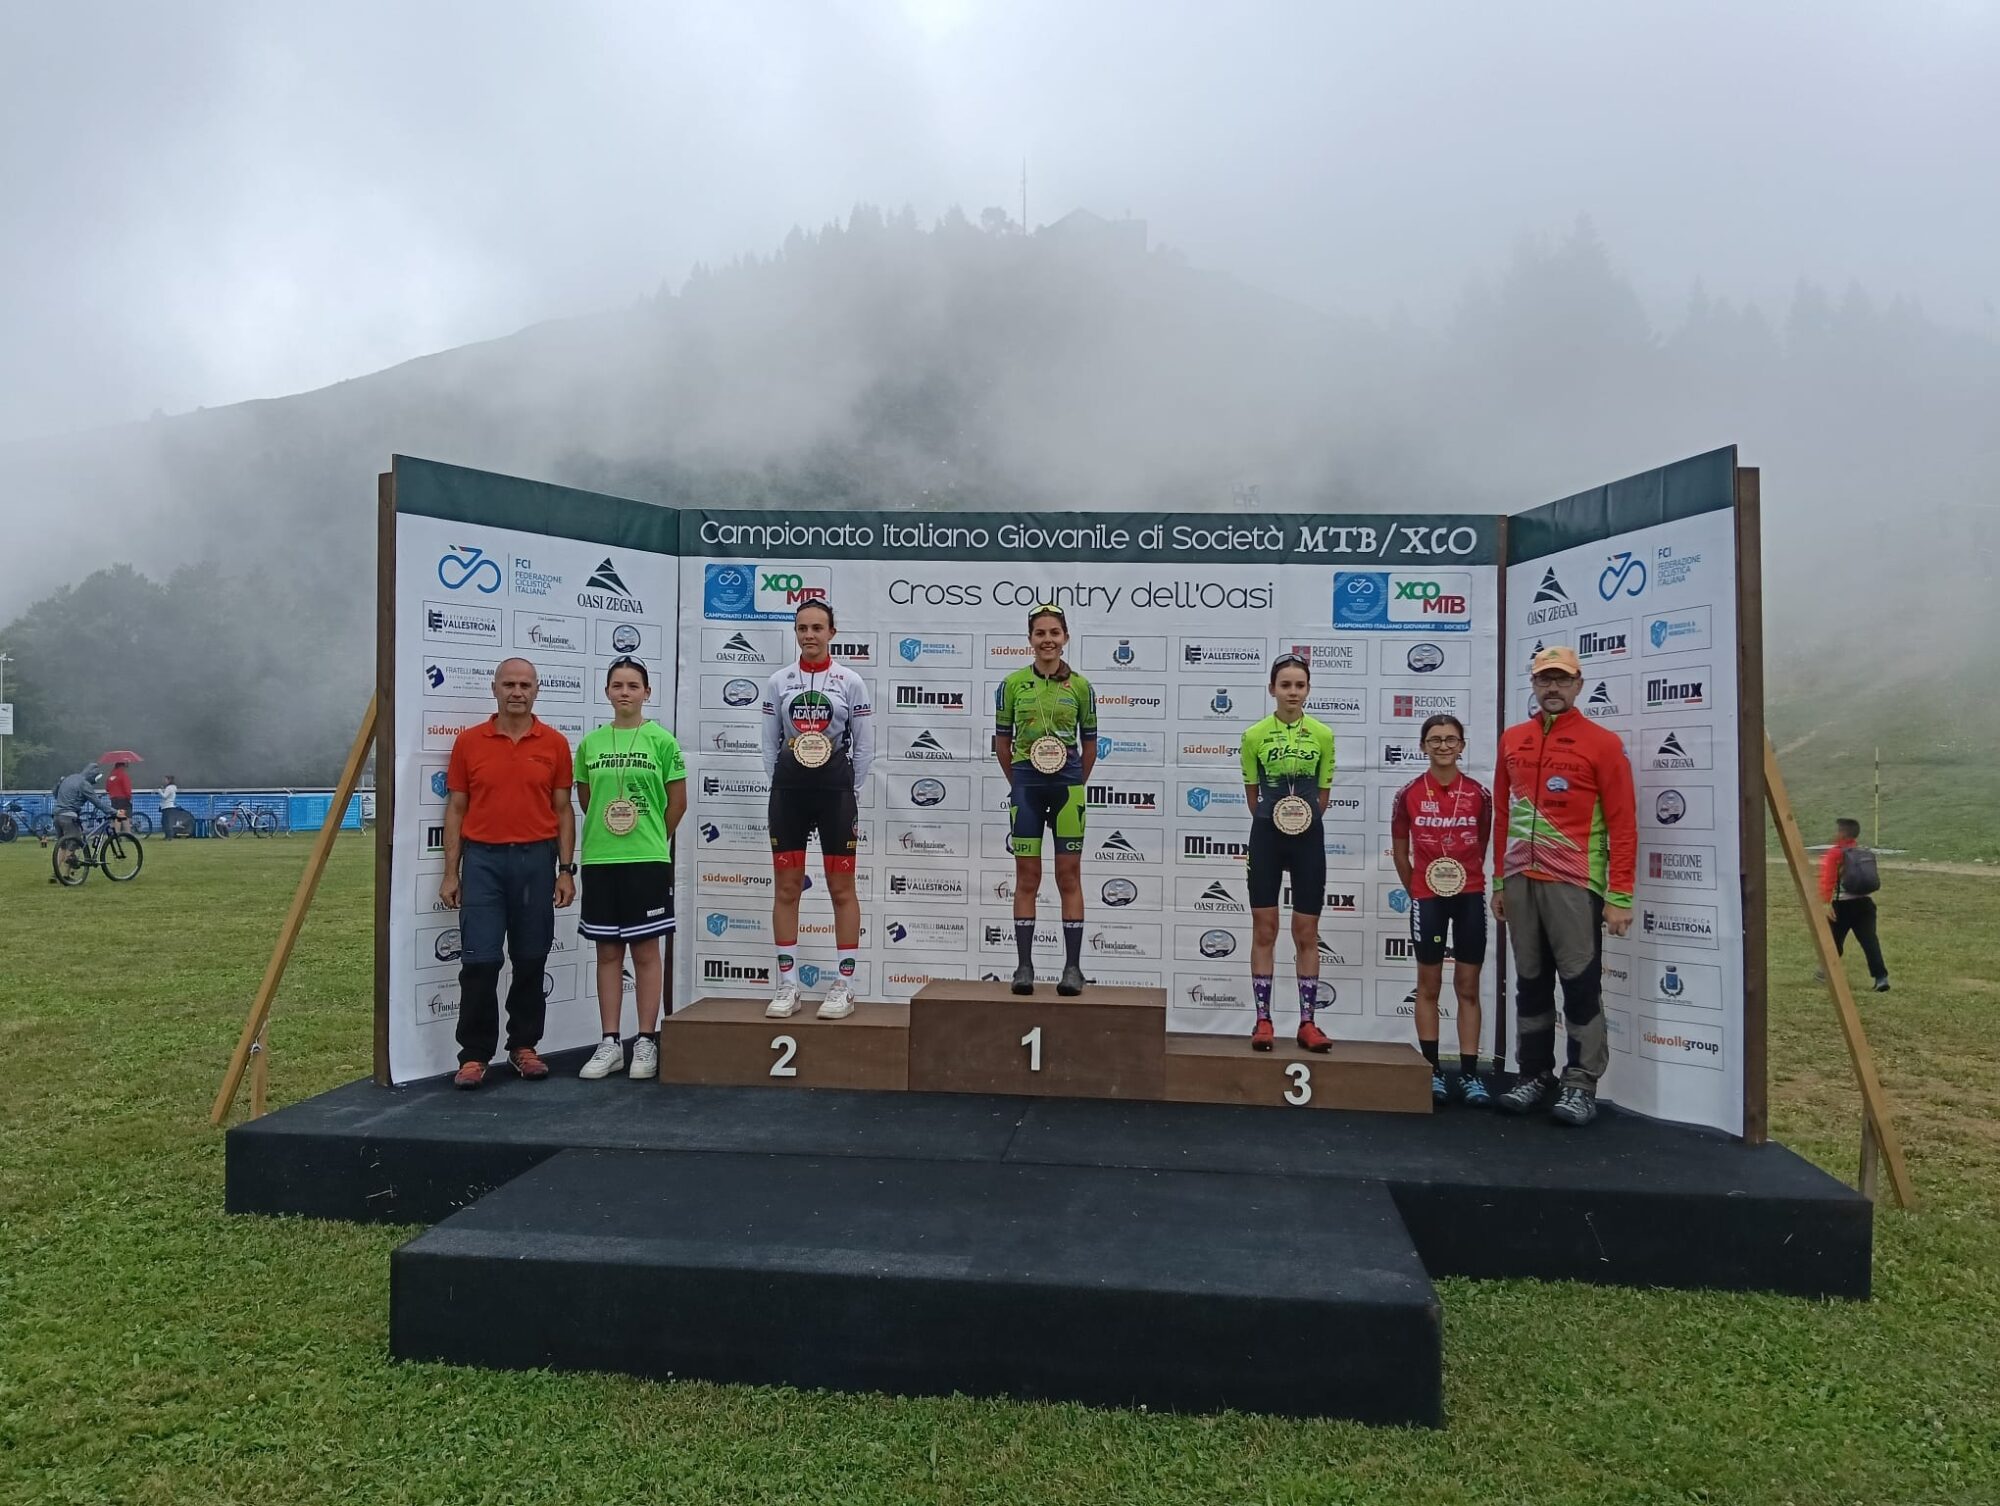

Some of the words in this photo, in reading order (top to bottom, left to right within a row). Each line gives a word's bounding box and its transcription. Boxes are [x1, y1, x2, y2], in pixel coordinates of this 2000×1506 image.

[700, 521, 873, 550] Campionato
[883, 523, 988, 549] Italiano
[997, 524, 1129, 550] Giovanile
[1138, 525, 1162, 550] di
[1172, 524, 1283, 551] Società
[1293, 523, 1478, 558] MTB/XCO
[1658, 547, 1672, 559] FCI
[515, 558, 531, 569] FCI
[515, 570, 563, 584] FEDERAZIONE
[761, 573, 803, 592] XCO
[515, 579, 552, 590] CICLISTICA
[515, 586, 547, 596] ITALIANA
[889, 579, 982, 606] Cross
[992, 580, 1122, 612] Country
[1131, 580, 1274, 610] dell'Oasi
[1394, 582, 1440, 600] XCO
[577, 592, 604, 609] OASI
[605, 597, 644, 615] ZEGNA
[1423, 595, 1465, 614] MTB
[1527, 609, 1547, 625] OASI
[1548, 602, 1578, 622] ZEGNA
[443, 620, 496, 632] VALLESTRONA
[1202, 652, 1260, 661] VALLESTRONA
[1312, 646, 1353, 657] REGIONE
[716, 652, 736, 661] OASI
[737, 653, 765, 663] ZEGNA
[1312, 659, 1352, 669] PIEMONTE
[538, 679, 581, 689] ALLESTRONA
[1414, 696, 1456, 708] REGIONE
[905, 750, 924, 760] OASI
[925, 751, 953, 760] ZEGNA
[1653, 759, 1670, 769] OASI
[1670, 758, 1695, 769] ZEGNA
[1095, 852, 1113, 860] OASI
[1114, 852, 1145, 861] ZEGNA
[1663, 853, 1702, 868] REGIONE
[1662, 870, 1703, 881] PIEMONTE
[906, 882, 963, 892] VALLESTRONA
[1194, 902, 1214, 911] OASI
[1215, 903, 1245, 912] ZEGNA
[935, 923, 964, 931] DALL'ARA
[1020, 1027, 1041, 1072] 1
[769, 1035, 798, 1078] 2
[1283, 1063, 1313, 1106] 3
